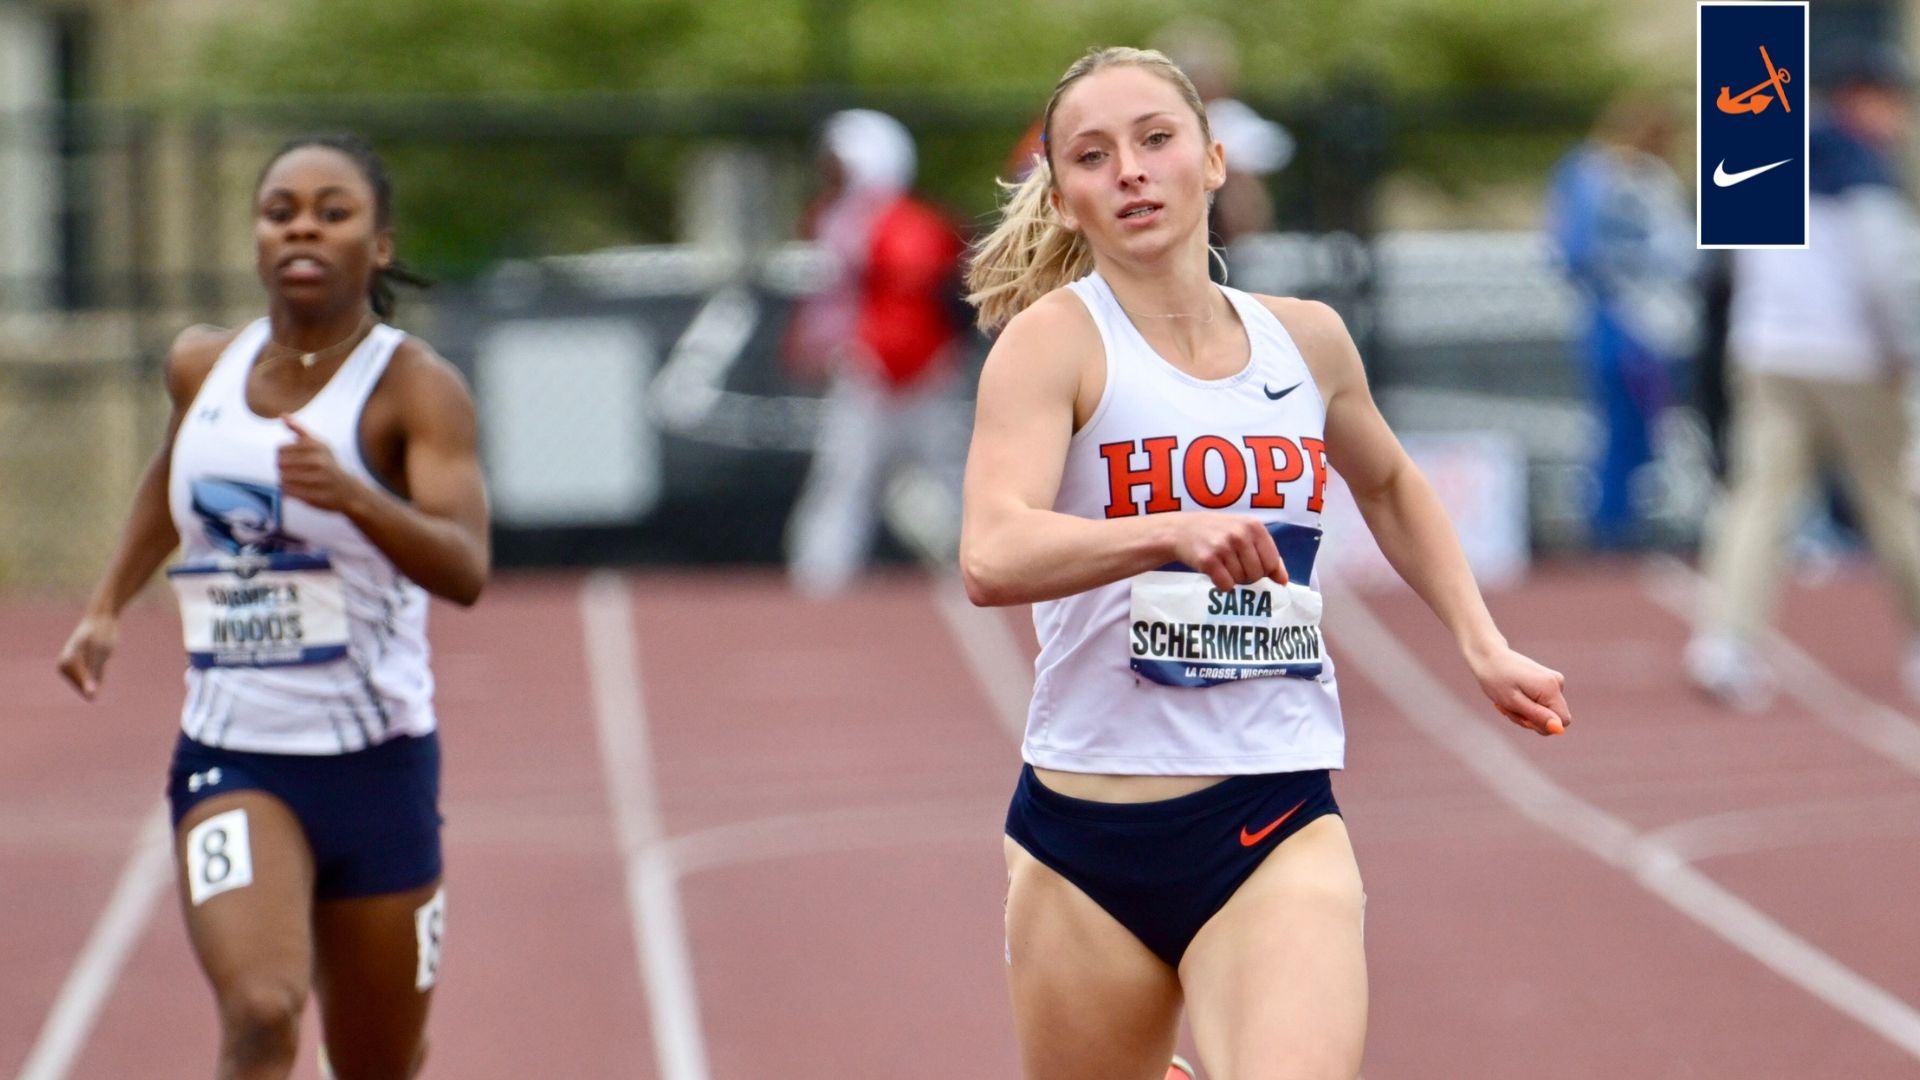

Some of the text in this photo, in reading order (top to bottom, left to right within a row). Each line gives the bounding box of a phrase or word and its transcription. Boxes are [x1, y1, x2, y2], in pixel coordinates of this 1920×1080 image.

[1208, 587, 1272, 617] SARA
[1132, 620, 1318, 660] SCHERMERHORN
[1185, 667, 1197, 678] LA
[203, 828, 231, 884] 8
